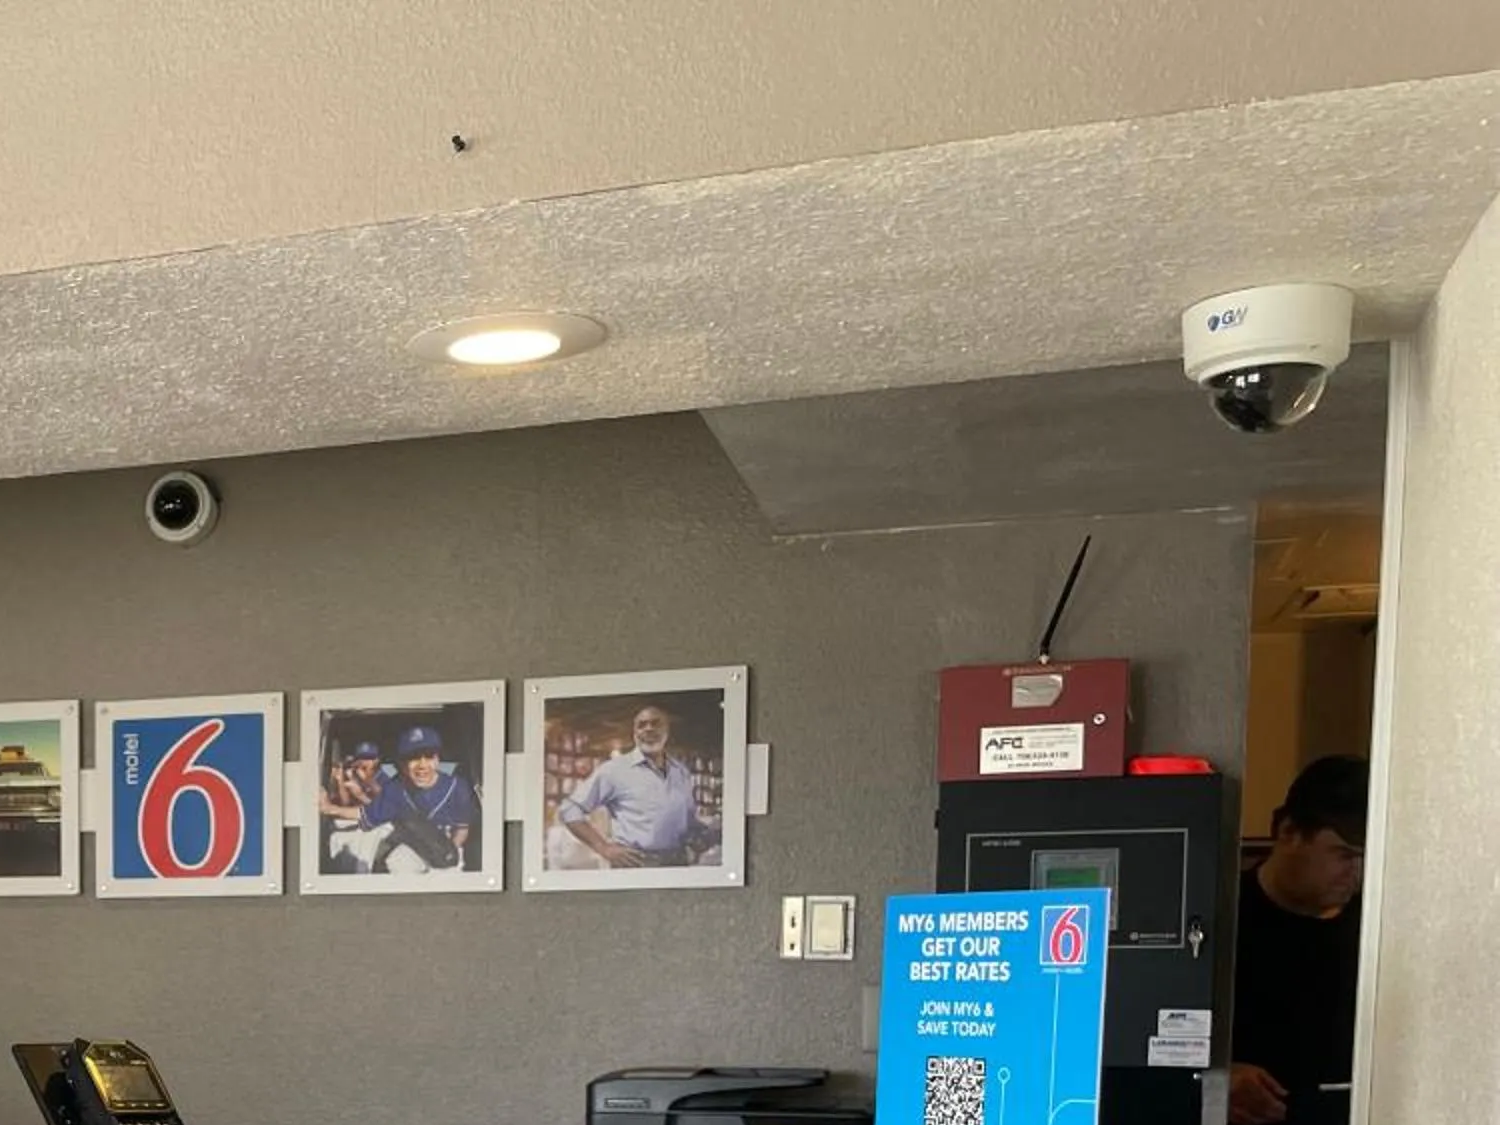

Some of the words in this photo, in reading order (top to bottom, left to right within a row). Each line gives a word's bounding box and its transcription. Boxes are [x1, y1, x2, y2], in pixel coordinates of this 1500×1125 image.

[123, 733, 140, 785] motel
[138, 719, 244, 878] 6
[899, 913, 935, 933] MY6
[939, 910, 1029, 932] MEMBERS
[1049, 905, 1083, 965] 6
[921, 937, 957, 956] GET
[960, 936, 1000, 956] OUR
[909, 963, 952, 981] BEST
[956, 961, 1011, 981] RATES
[919, 1000, 951, 1017] JOIN
[953, 1001, 981, 1017] MY6
[984, 1002, 994, 1017] &
[916, 1020, 949, 1036] SAVE
[952, 1021, 997, 1037] TODAY
